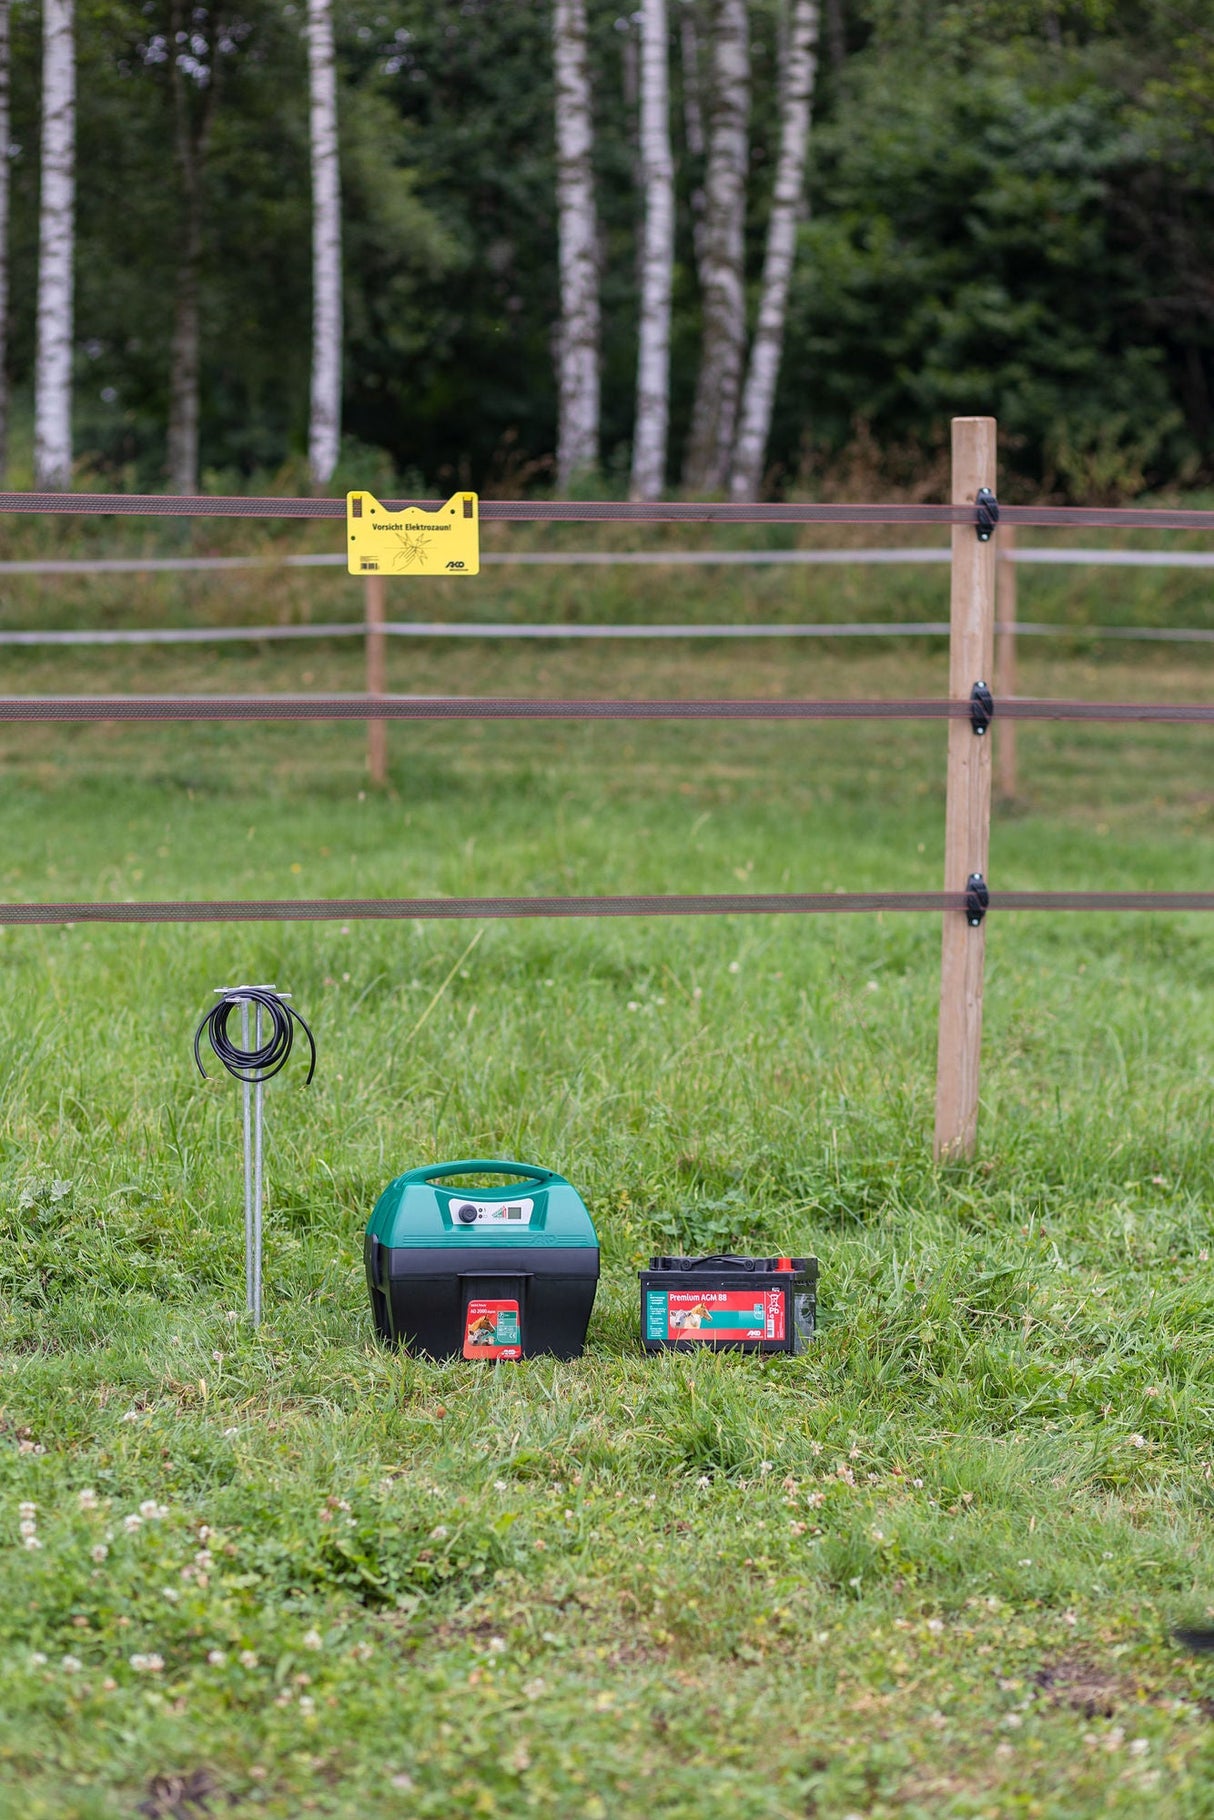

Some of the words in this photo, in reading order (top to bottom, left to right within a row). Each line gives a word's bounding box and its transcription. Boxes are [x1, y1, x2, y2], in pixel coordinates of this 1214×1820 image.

[372, 523, 403, 531] Vorsicht
[405, 523, 452, 531] Elektrozaun!
[669, 1293, 700, 1302] Premium
[700, 1293, 717, 1302] AGM
[718, 1294, 728, 1302] 88
